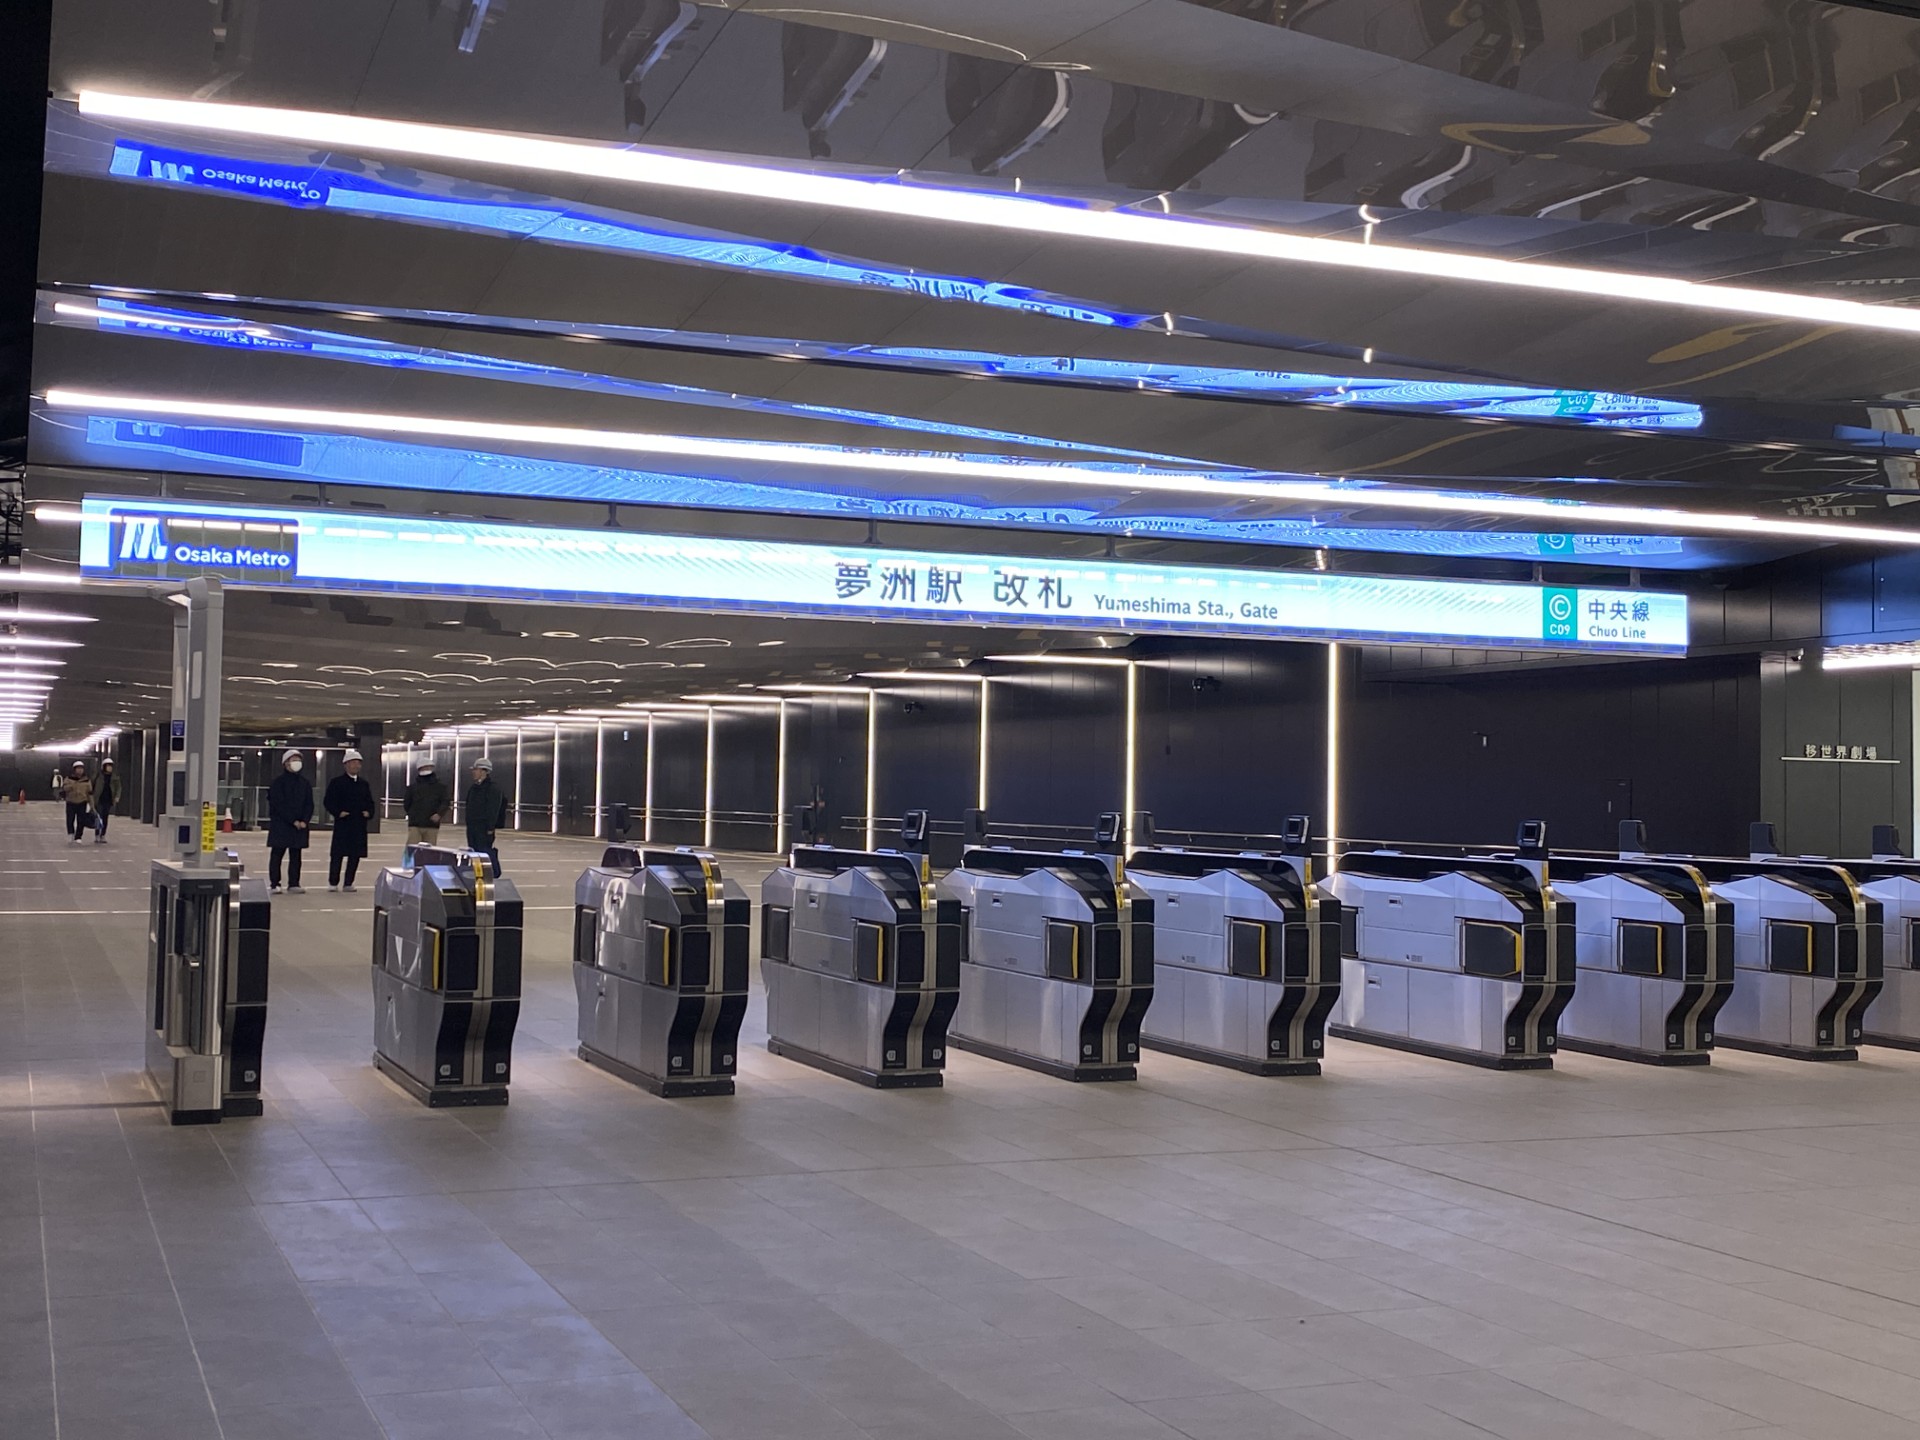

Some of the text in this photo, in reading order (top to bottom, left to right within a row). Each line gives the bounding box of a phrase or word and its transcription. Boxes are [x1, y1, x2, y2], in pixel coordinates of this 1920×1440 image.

[174, 546, 291, 567] Osaka Metro
[834, 561, 964, 605] 夢洲駅
[993, 569, 1073, 609] 改札
[1093, 594, 1192, 615] Yumeshima
[1240, 602, 1278, 620] Gate
[1588, 598, 1650, 622] 中央線
[1549, 623, 1571, 635] C09
[1588, 625, 1647, 639] Chuo Line
